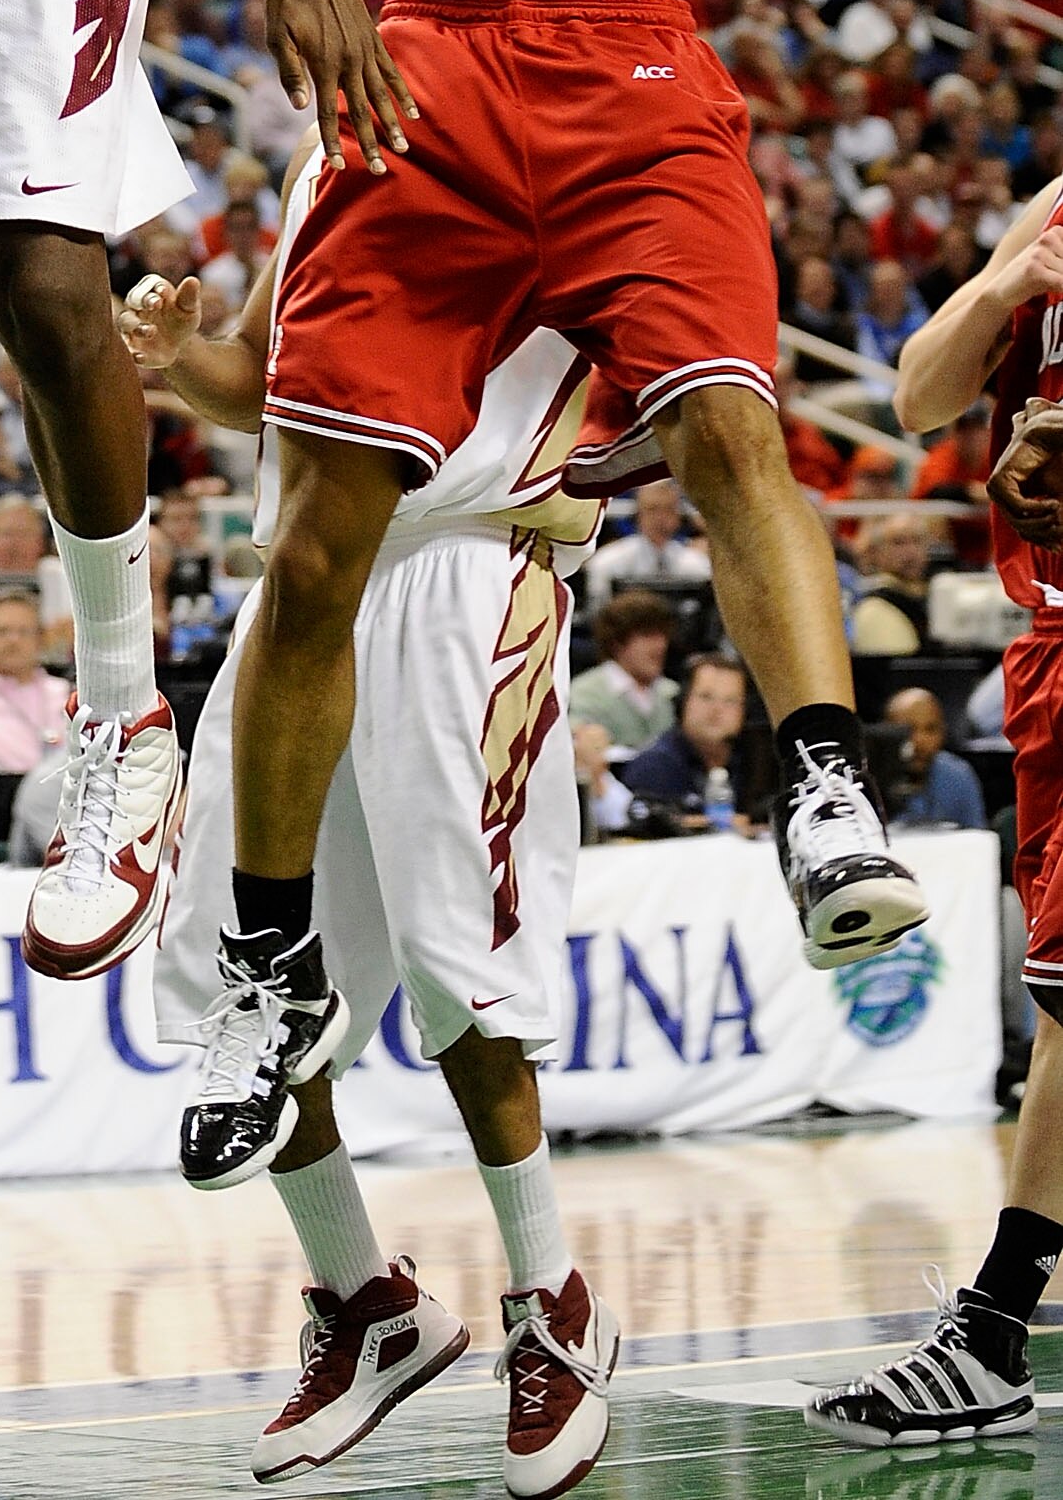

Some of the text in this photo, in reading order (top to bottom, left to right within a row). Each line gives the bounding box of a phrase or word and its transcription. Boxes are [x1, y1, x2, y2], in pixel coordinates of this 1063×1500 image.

[631, 64, 676, 80] ACC
[362, 1315, 417, 1364] FREE JORDAN
